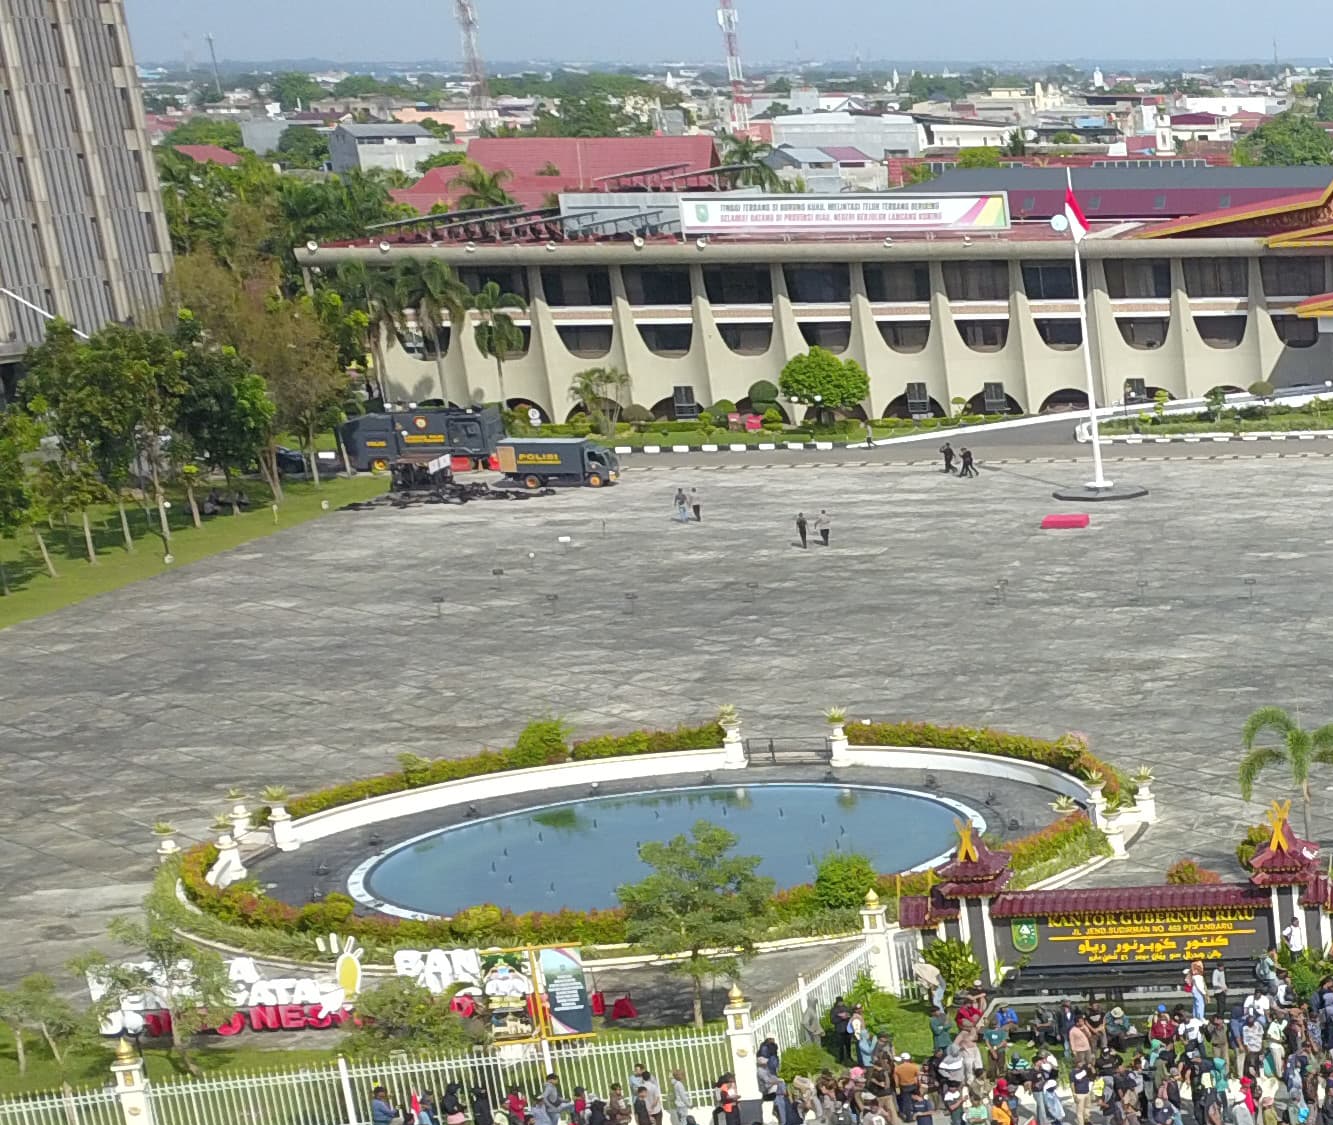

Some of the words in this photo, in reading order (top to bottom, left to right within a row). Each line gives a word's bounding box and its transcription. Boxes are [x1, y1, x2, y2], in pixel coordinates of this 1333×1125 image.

[1047, 912, 1118, 928] KANTOR
[1119, 909, 1211, 926] GUBERNUR
[1215, 908, 1256, 922] RIAU
[1183, 923, 1233, 932] PEKANBARU
